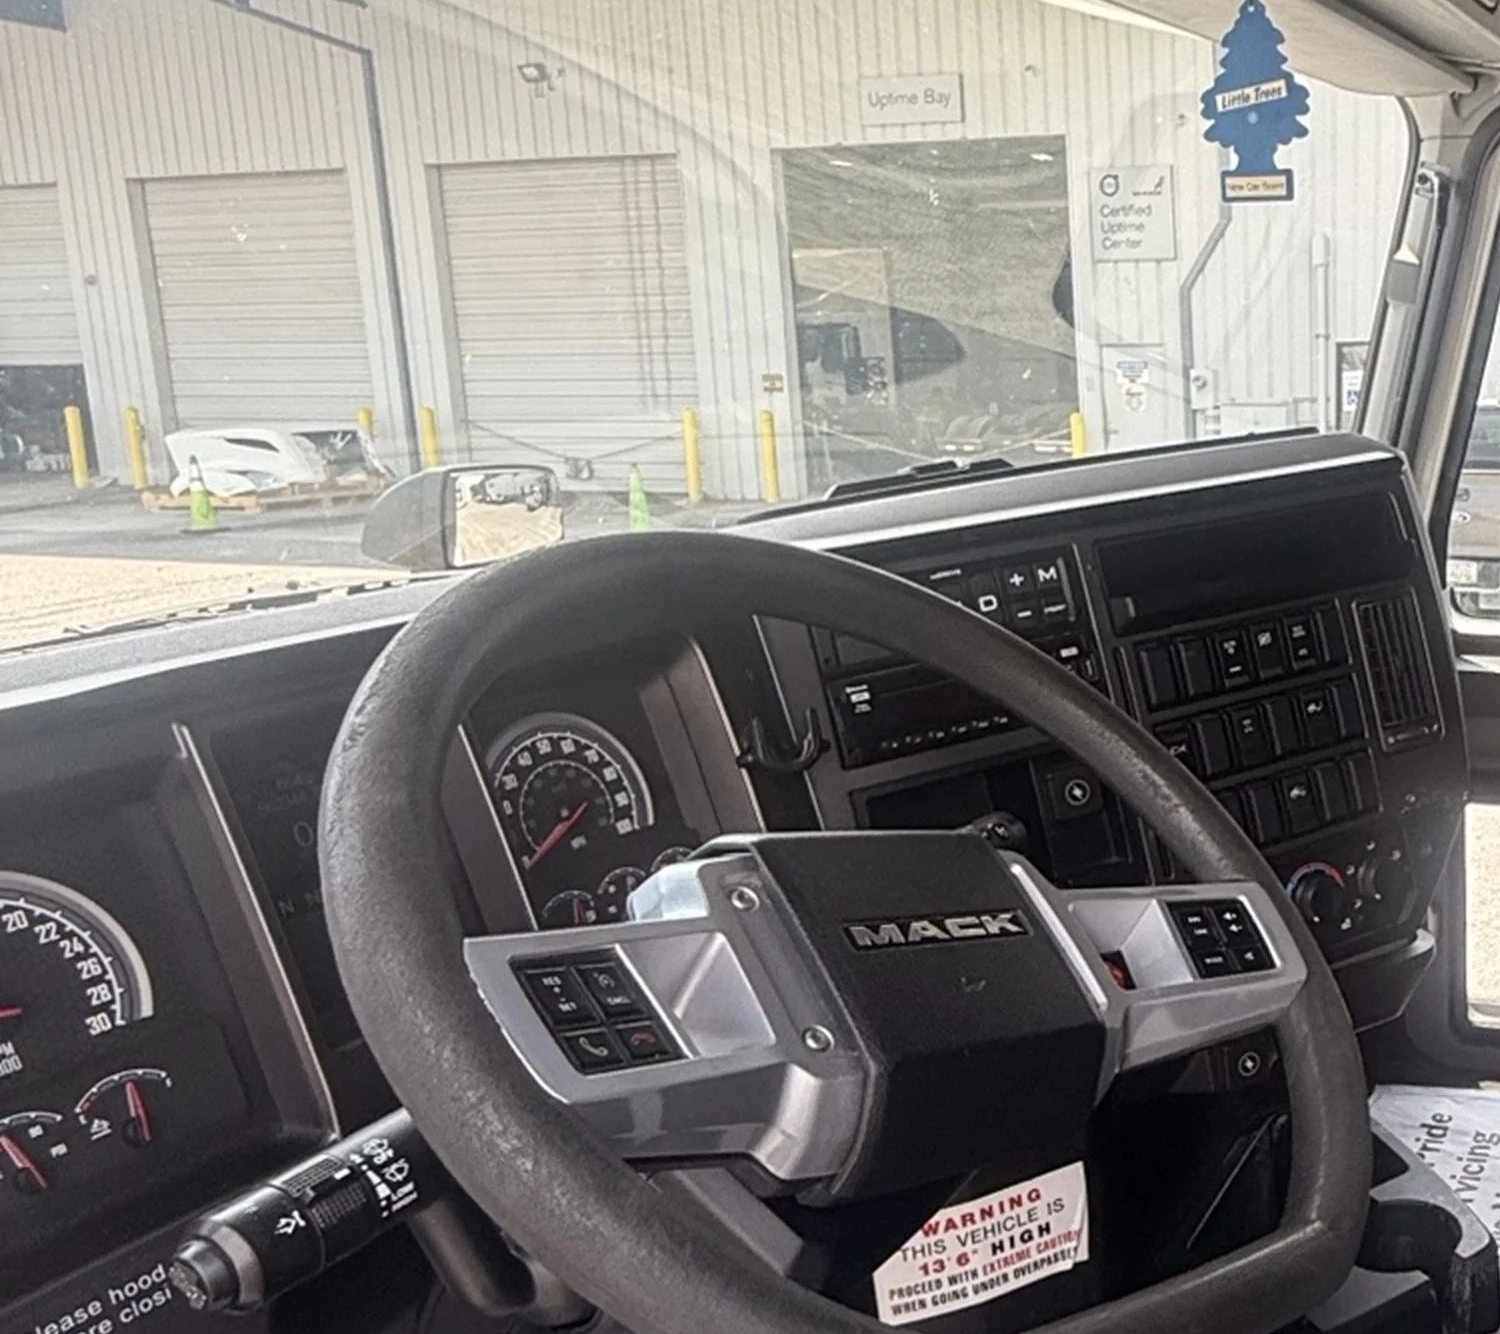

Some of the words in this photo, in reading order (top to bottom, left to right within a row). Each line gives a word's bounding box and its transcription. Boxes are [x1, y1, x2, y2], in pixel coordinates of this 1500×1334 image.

[868, 89, 918, 110] Uptime
[924, 87, 952, 109] Bay
[1221, 92, 1250, 109] Little
[1253, 85, 1283, 101] Trees
[1100, 203, 1152, 218] Certified
[1101, 221, 1145, 235] Uptime
[1102, 236, 1142, 251] Center
[1037, 566, 1057, 582] M
[978, 594, 998, 612] D
[2, 910, 28, 933] 20
[33, 921, 60, 944] 22
[849, 913, 1024, 947] MACK
[59, 936, 84, 958] 24
[77, 957, 103, 979] 26
[86, 983, 112, 1006] 28
[85, 1012, 112, 1035] 30
[1415, 1112, 1453, 1164] ride
[921, 1188, 1042, 1238] WARNING
[900, 1239, 947, 1263] THIS
[956, 1207, 1040, 1247] VEHICLE
[1046, 1197, 1065, 1215] IS
[992, 1222, 1051, 1257] HIGH
[108, 1263, 167, 1306] hood
[889, 1274, 943, 1301] PROCEED
[950, 1265, 979, 1287] WITH
[982, 1248, 1032, 1277] EXTREME
[119, 1283, 172, 1323] closi
[891, 1297, 927, 1317] WHEN
[932, 1286, 970, 1307] GOING
[972, 1270, 1010, 1296] UNDER
